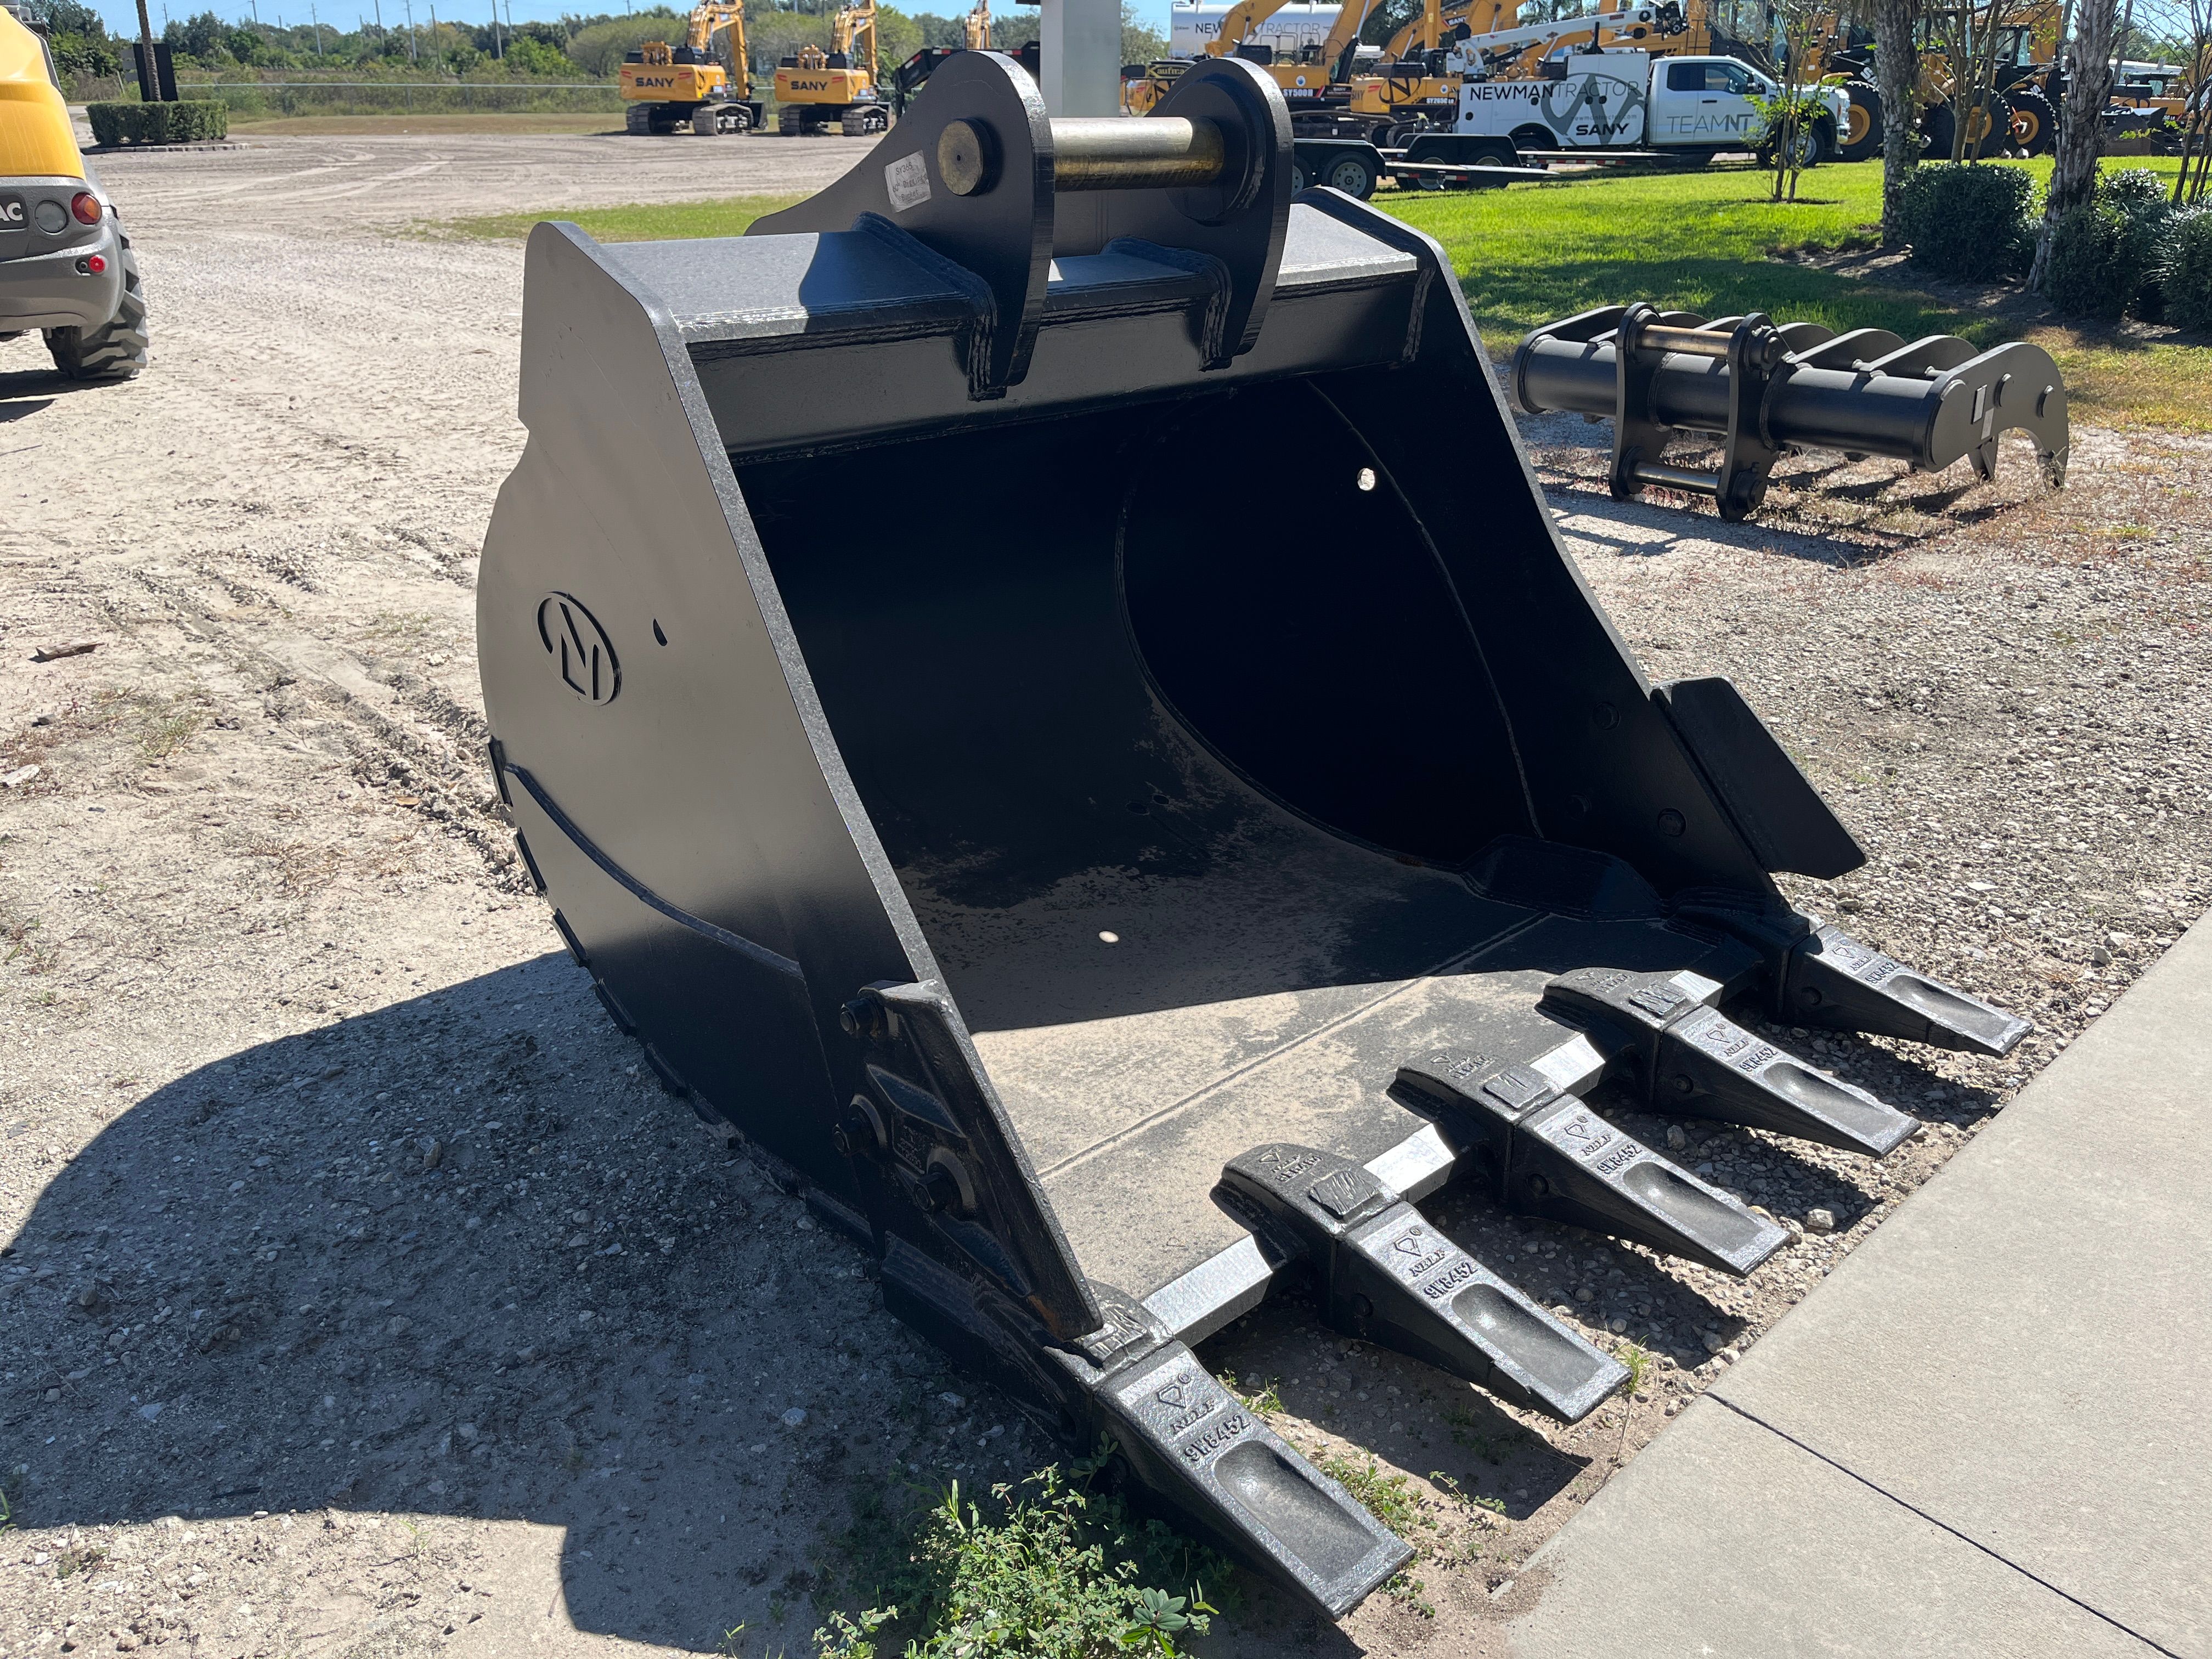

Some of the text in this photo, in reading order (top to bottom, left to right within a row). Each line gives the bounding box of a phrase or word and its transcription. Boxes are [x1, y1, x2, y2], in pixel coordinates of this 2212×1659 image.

[1448, 16, 1466, 25] SANY
[1147, 65, 1186, 78] Kaufma
[636, 77, 674, 87] SANY
[791, 81, 827, 90] SANY
[1576, 123, 1629, 135] SANY
